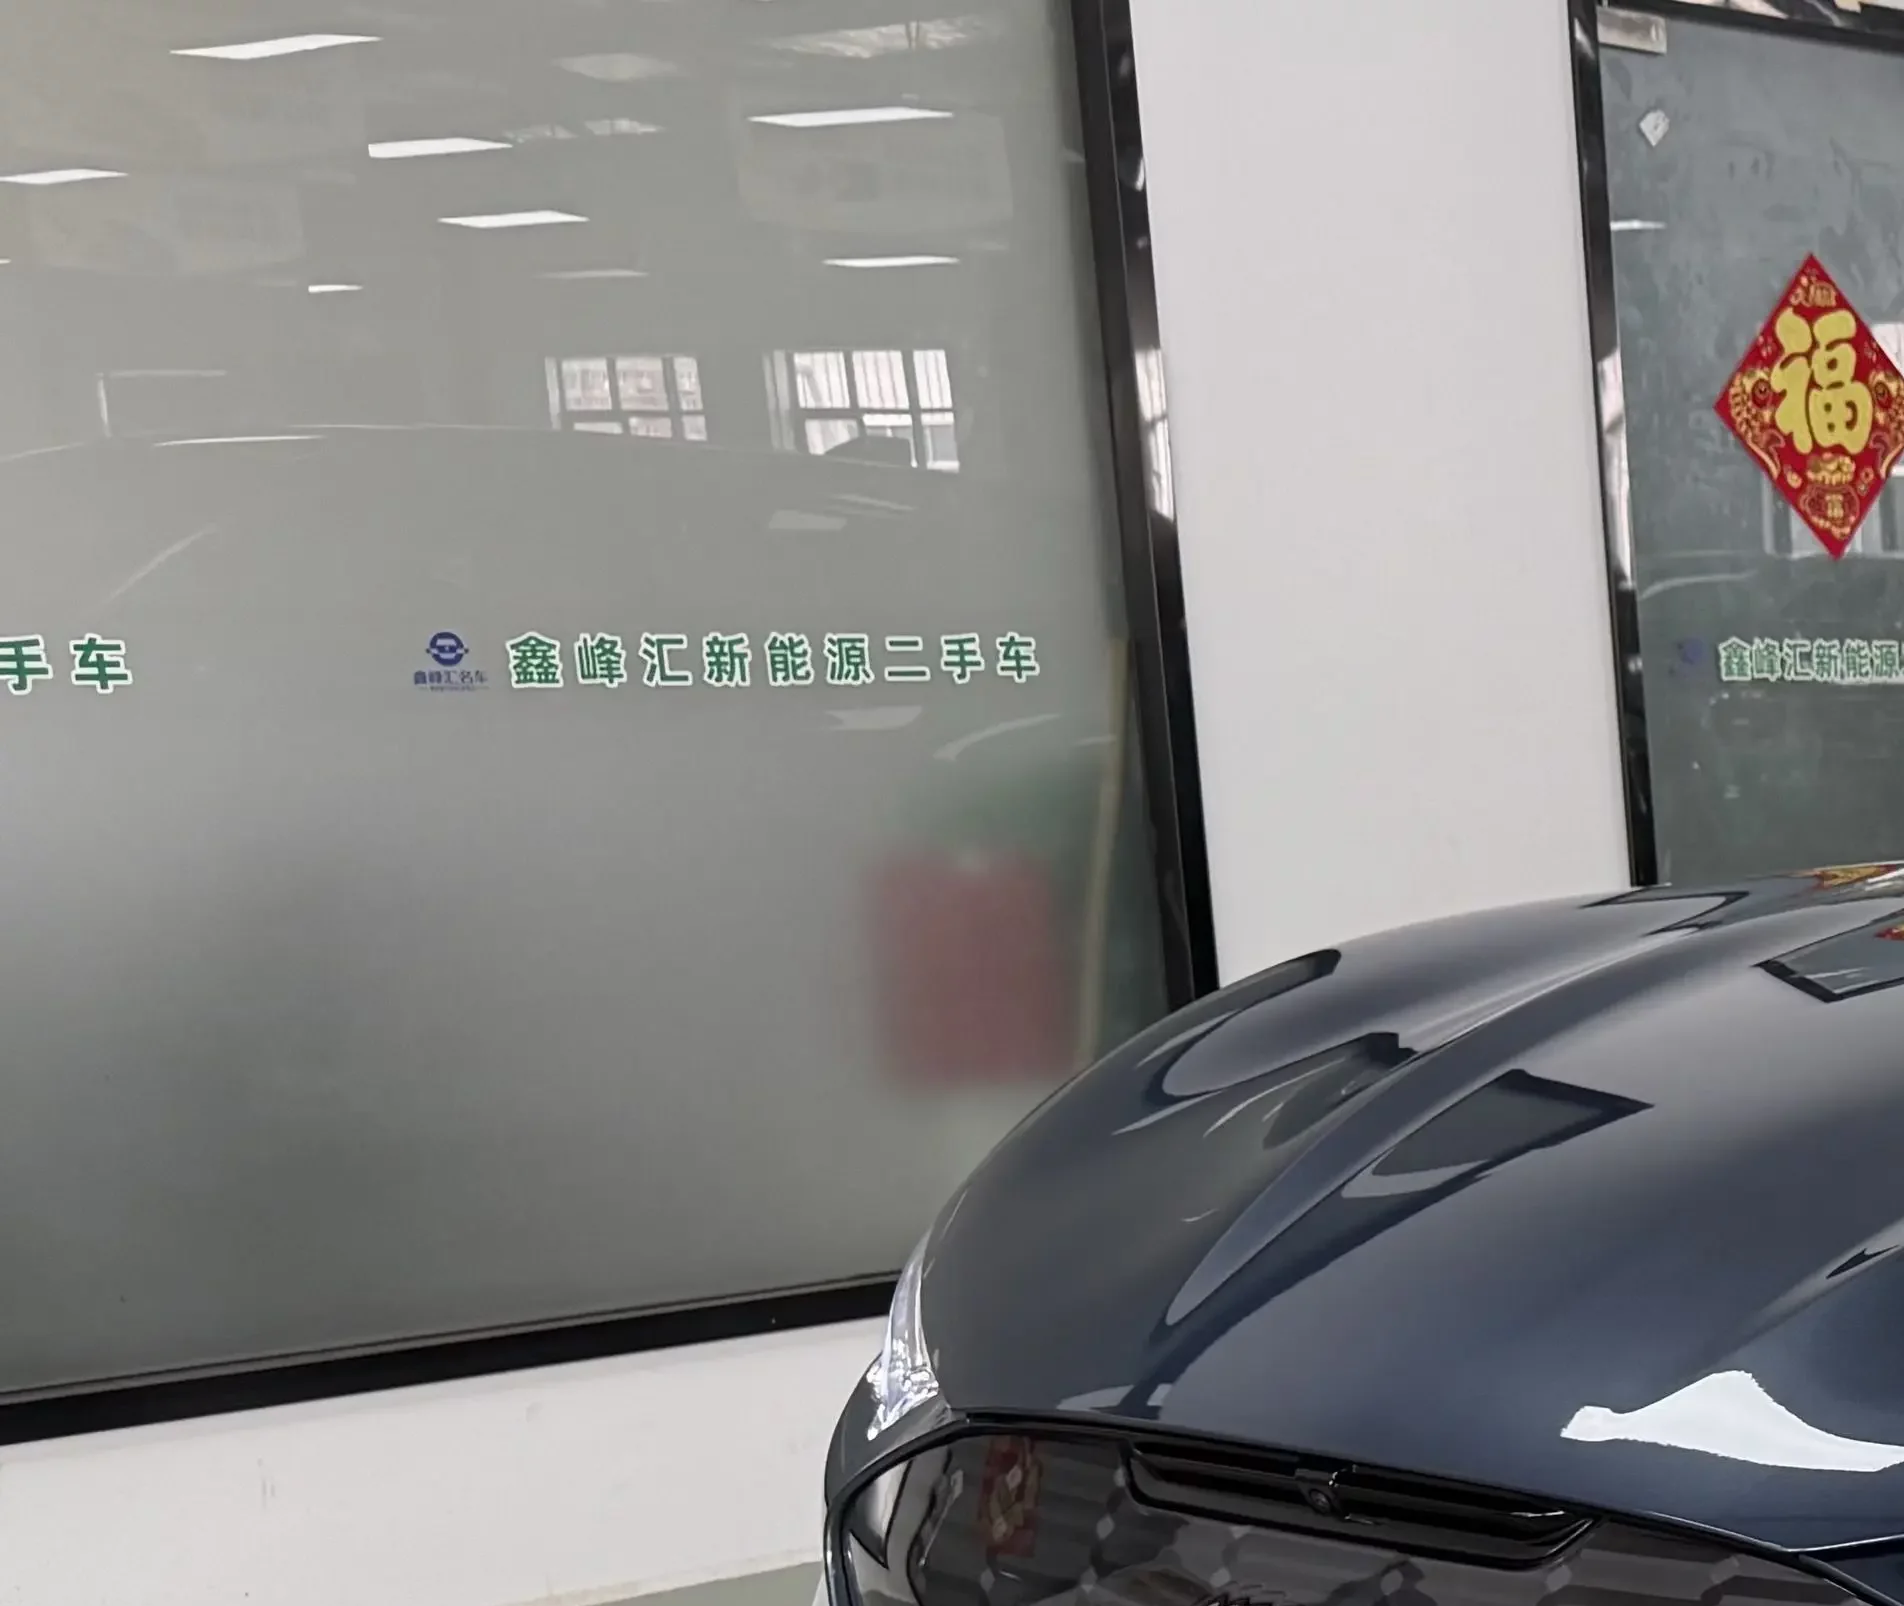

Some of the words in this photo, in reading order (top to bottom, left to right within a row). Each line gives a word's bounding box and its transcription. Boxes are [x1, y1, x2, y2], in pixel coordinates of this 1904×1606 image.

[1769, 308, 1873, 454] 福
[0, 633, 133, 695] 手车
[505, 633, 1040, 689] 鑫峰汇新能源二手车
